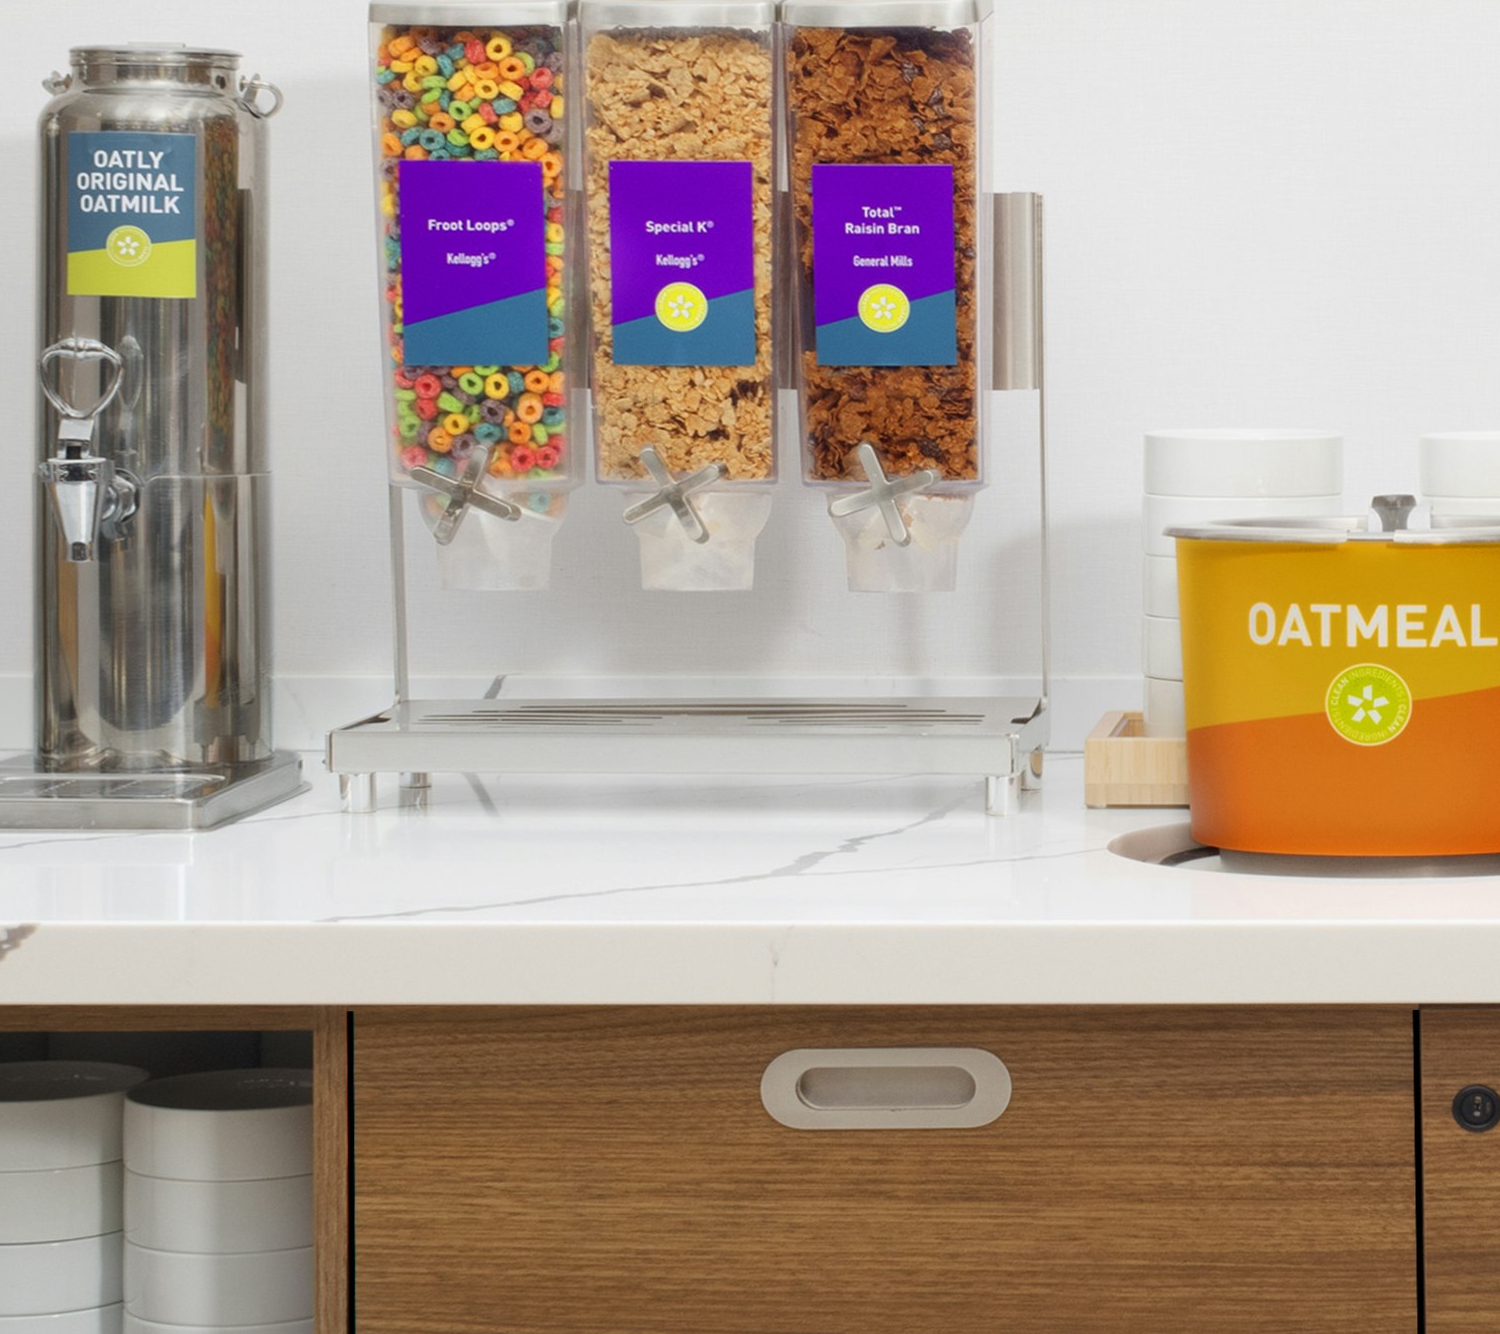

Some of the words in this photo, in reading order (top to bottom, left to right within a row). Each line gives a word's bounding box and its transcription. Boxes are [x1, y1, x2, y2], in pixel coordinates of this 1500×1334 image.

[93, 149, 164, 169] OATLY
[76, 172, 184, 192] ORIGINAL
[80, 194, 180, 214] OATMILK
[428, 219, 463, 231] Froot
[645, 220, 694, 235] Special
[845, 222, 885, 234] Raisin
[888, 222, 920, 234] Bran
[853, 255, 889, 267] General
[890, 255, 913, 267] Mills
[1248, 602, 1498, 648] OATMEAL
[1331, 677, 1349, 705] CLEAN
